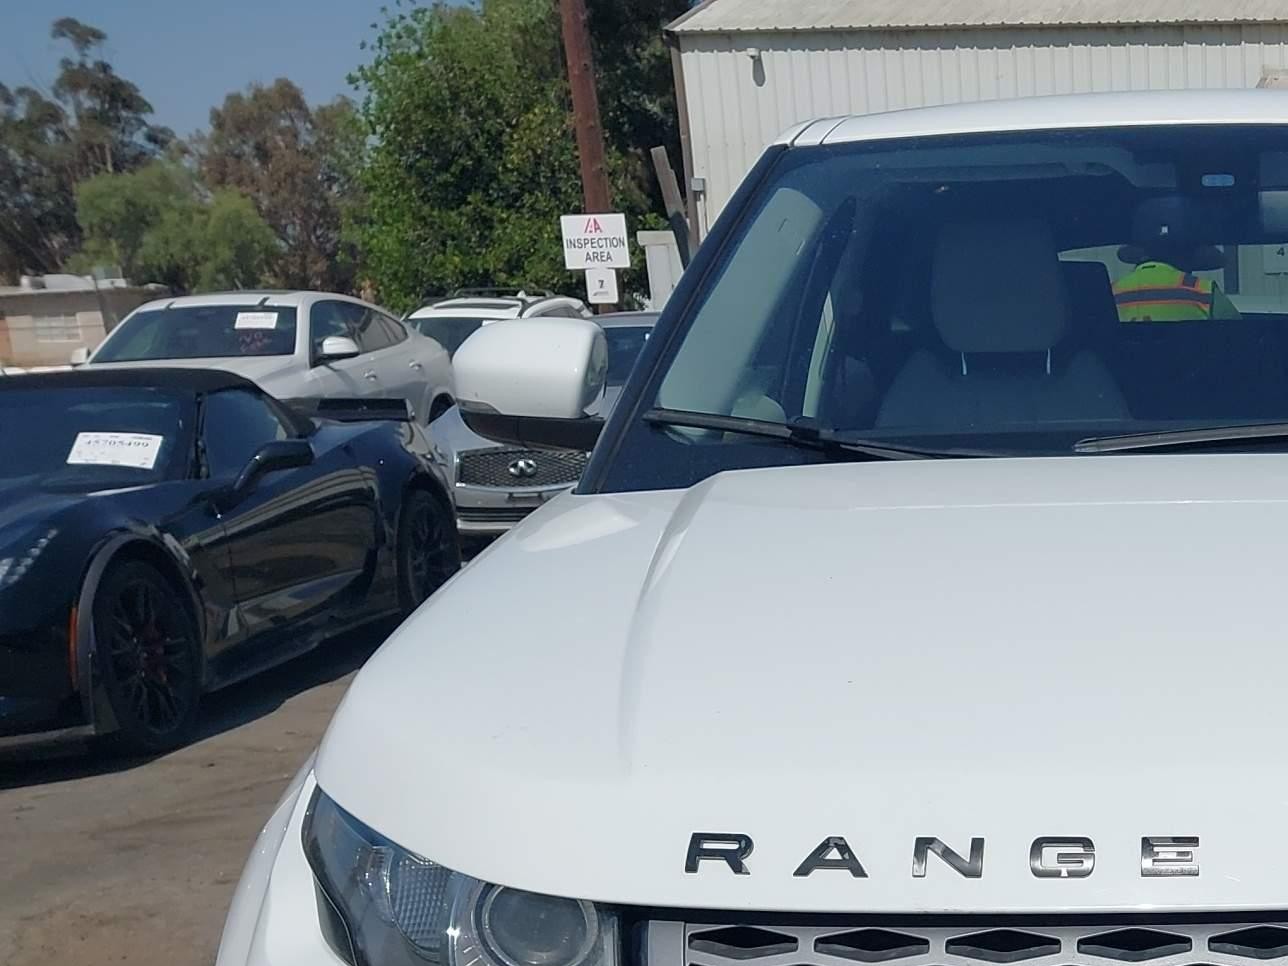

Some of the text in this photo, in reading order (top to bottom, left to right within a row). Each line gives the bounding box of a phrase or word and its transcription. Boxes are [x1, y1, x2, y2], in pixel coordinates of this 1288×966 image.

[566, 236, 626, 249] INSPECTION
[585, 251, 613, 263] AREA
[1276, 247, 1285, 257] 4
[598, 280, 605, 289] 7
[684, 832, 1199, 879] RANGE
